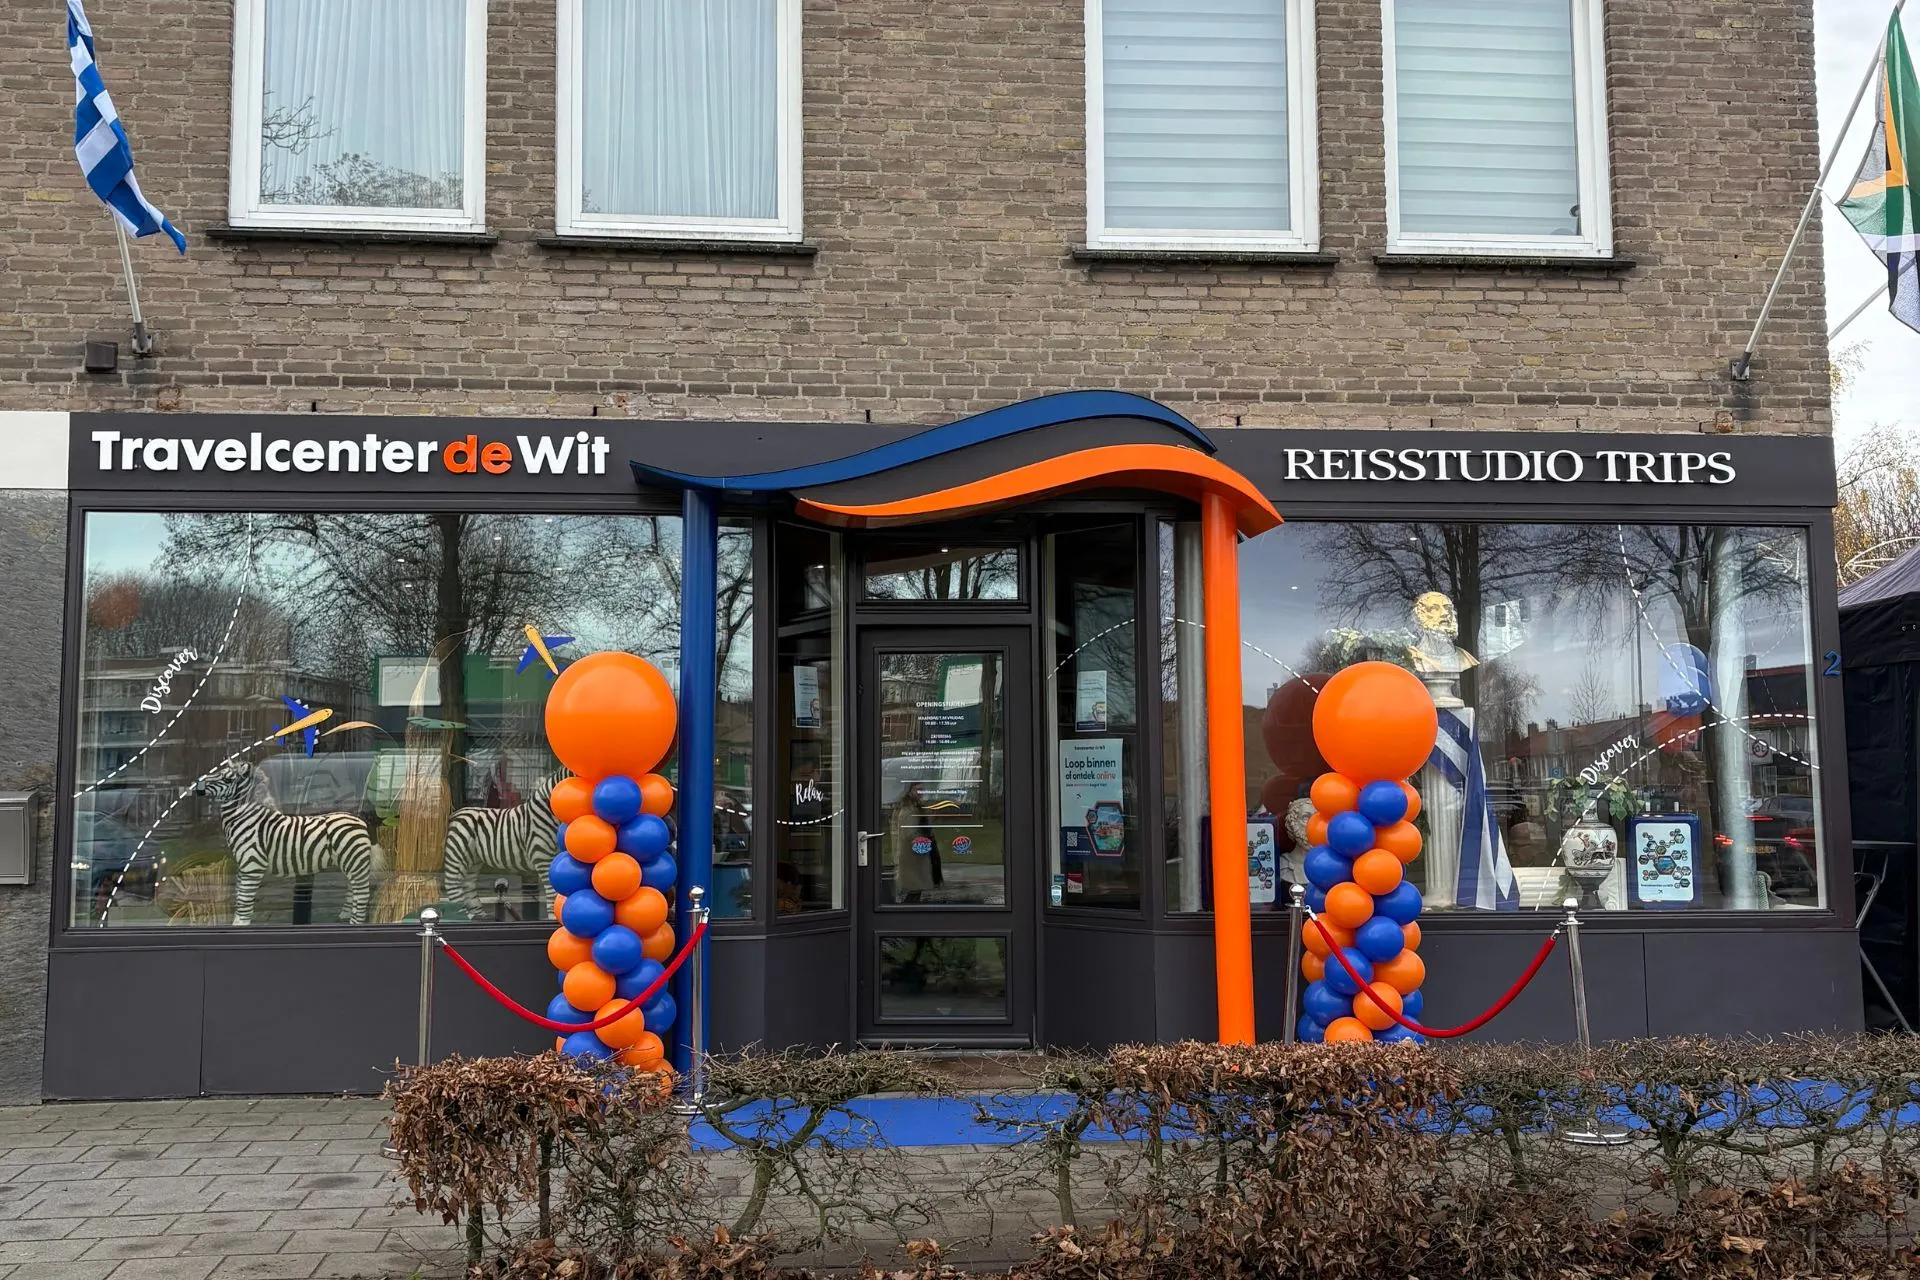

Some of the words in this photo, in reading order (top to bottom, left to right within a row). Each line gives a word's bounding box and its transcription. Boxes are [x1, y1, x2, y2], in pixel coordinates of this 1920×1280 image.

[92, 430, 438, 473] Travelcenter
[443, 434, 513, 474] de
[516, 431, 610, 474] Wit
[1283, 448, 1584, 482] REISSTUDIO
[1596, 451, 1737, 484] TRIPS
[1823, 650, 1842, 676] 2
[140, 647, 198, 714] Discover
[1064, 757, 1085, 770] Loop
[1086, 756, 1116, 768] binnen
[1065, 771, 1072, 780] of
[1072, 771, 1095, 780] ontdek
[1096, 770, 1116, 780] online
[1579, 734, 1640, 786] Discover
[795, 778, 824, 806] Relax
